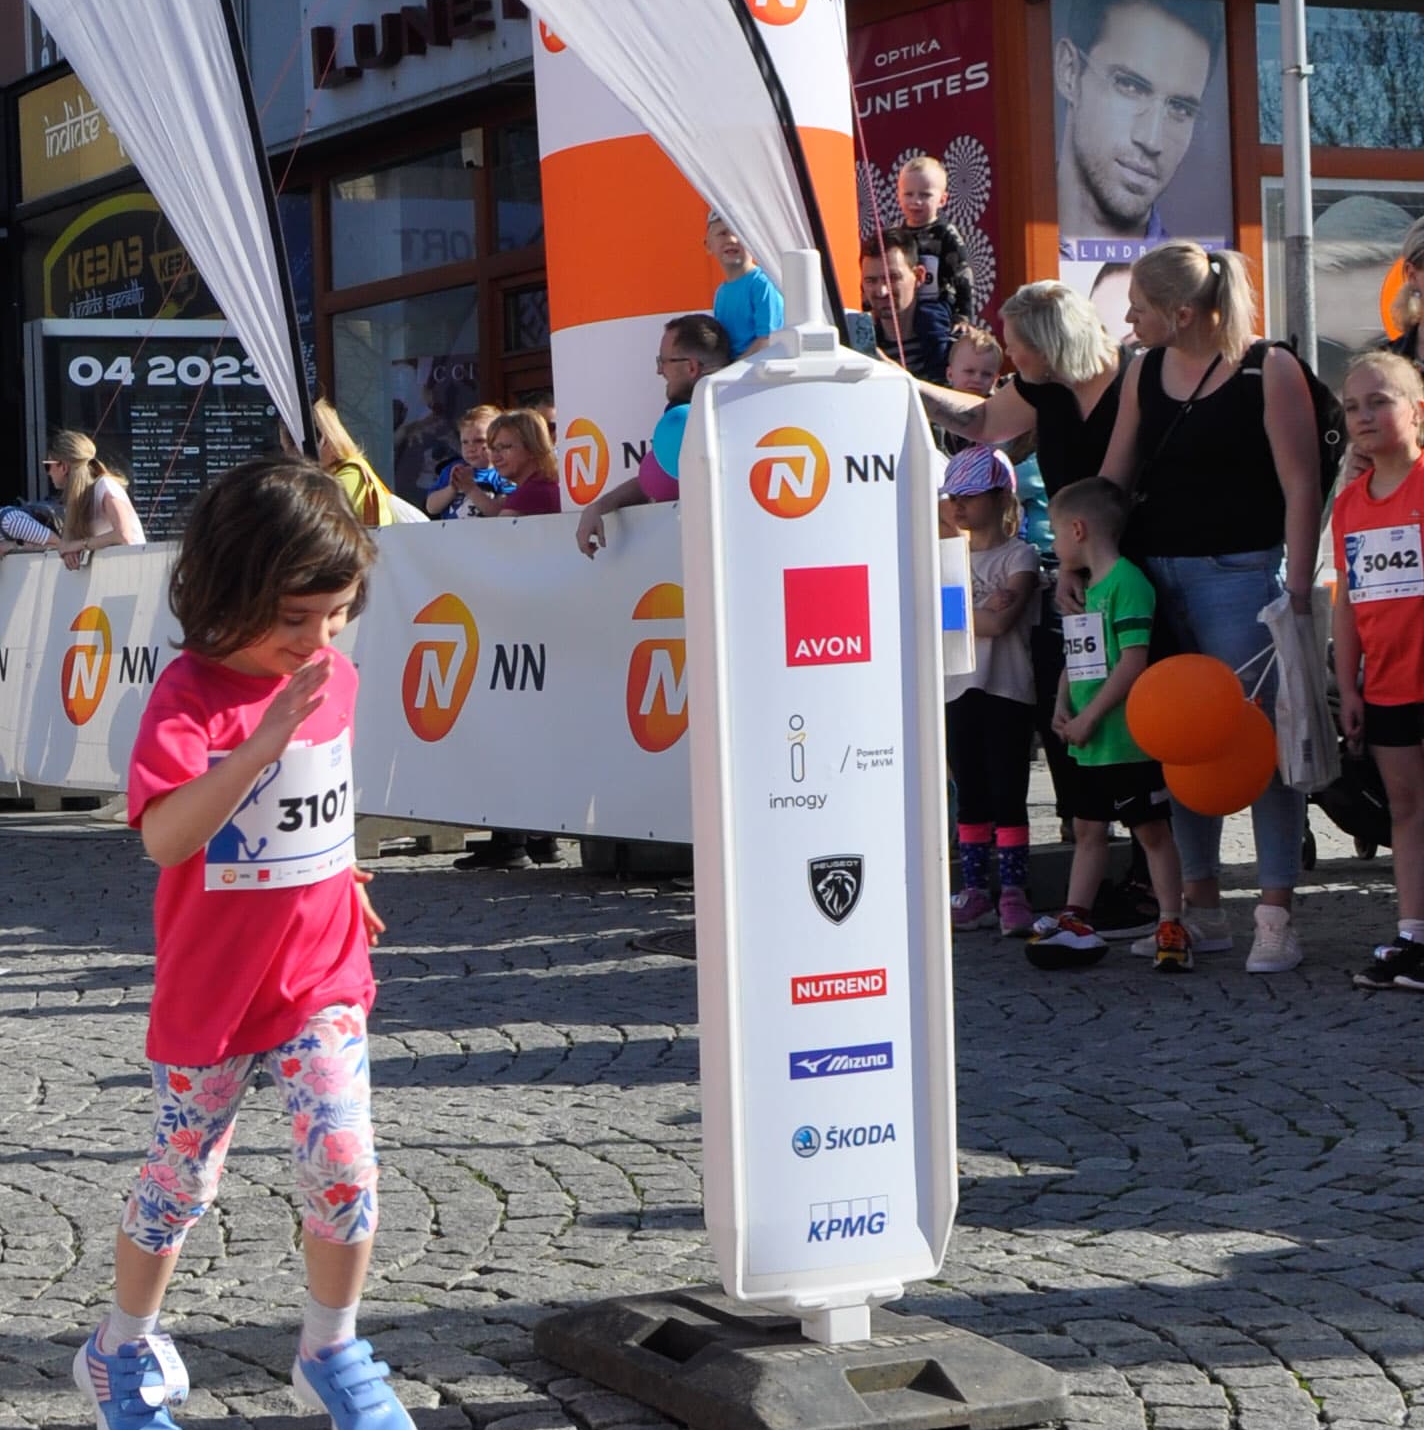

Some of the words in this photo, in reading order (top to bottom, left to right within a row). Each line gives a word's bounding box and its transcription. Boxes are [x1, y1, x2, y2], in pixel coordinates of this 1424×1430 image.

[874, 38, 941, 67] OPTIKA
[856, 61, 990, 119] UNETTES
[68, 355, 135, 387] 04
[845, 453, 896, 484] NN
[1363, 549, 1419, 573] 3042
[795, 636, 862, 659] AVON
[119, 646, 159, 684] NN
[490, 643, 546, 691] NN
[856, 746, 894, 759] Powered
[856, 760, 868, 771] by
[871, 757, 894, 768] MVM
[277, 781, 347, 832] 3107
[769, 792, 827, 810] innogy
[812, 859, 860, 872] PEUGEOT
[796, 974, 884, 999] NUTREND
[825, 1123, 896, 1151] ŠKODA
[807, 1211, 887, 1243] KPMG
